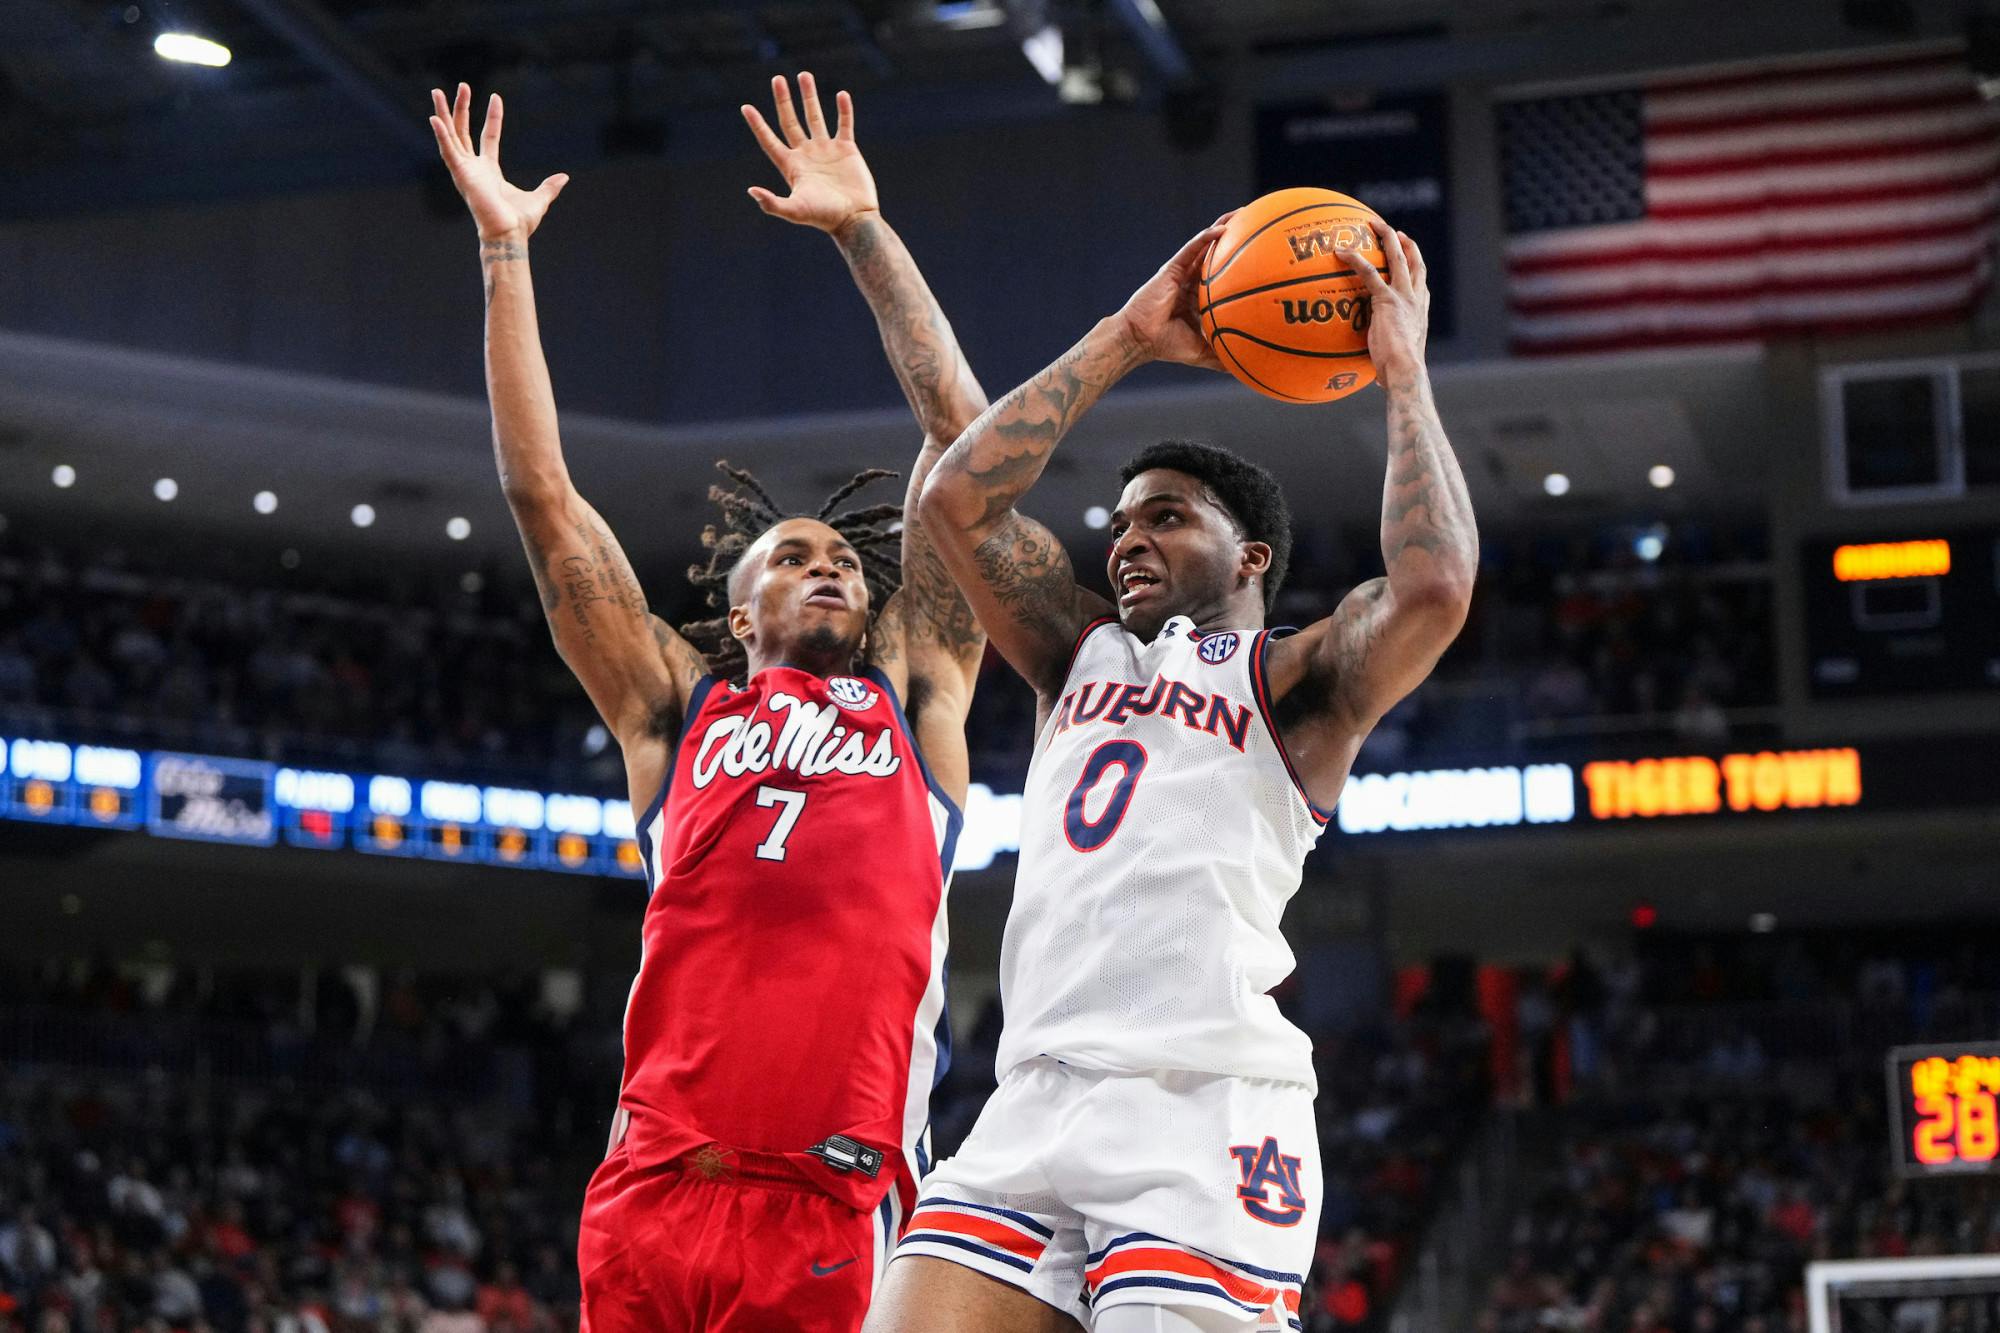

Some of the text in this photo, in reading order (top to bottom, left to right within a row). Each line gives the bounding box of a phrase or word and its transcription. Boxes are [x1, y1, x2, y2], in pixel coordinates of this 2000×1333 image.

[1200, 634, 1238, 663] SEC
[828, 676, 867, 704] SEC
[692, 691, 902, 790] Ole Miss
[1063, 739, 1149, 854] 0
[1582, 756, 1720, 819] TIGER
[1721, 747, 1862, 812] TOWN
[755, 785, 807, 862] 7
[860, 1153, 874, 1167] 46
[1913, 1092, 1999, 1164] 28
